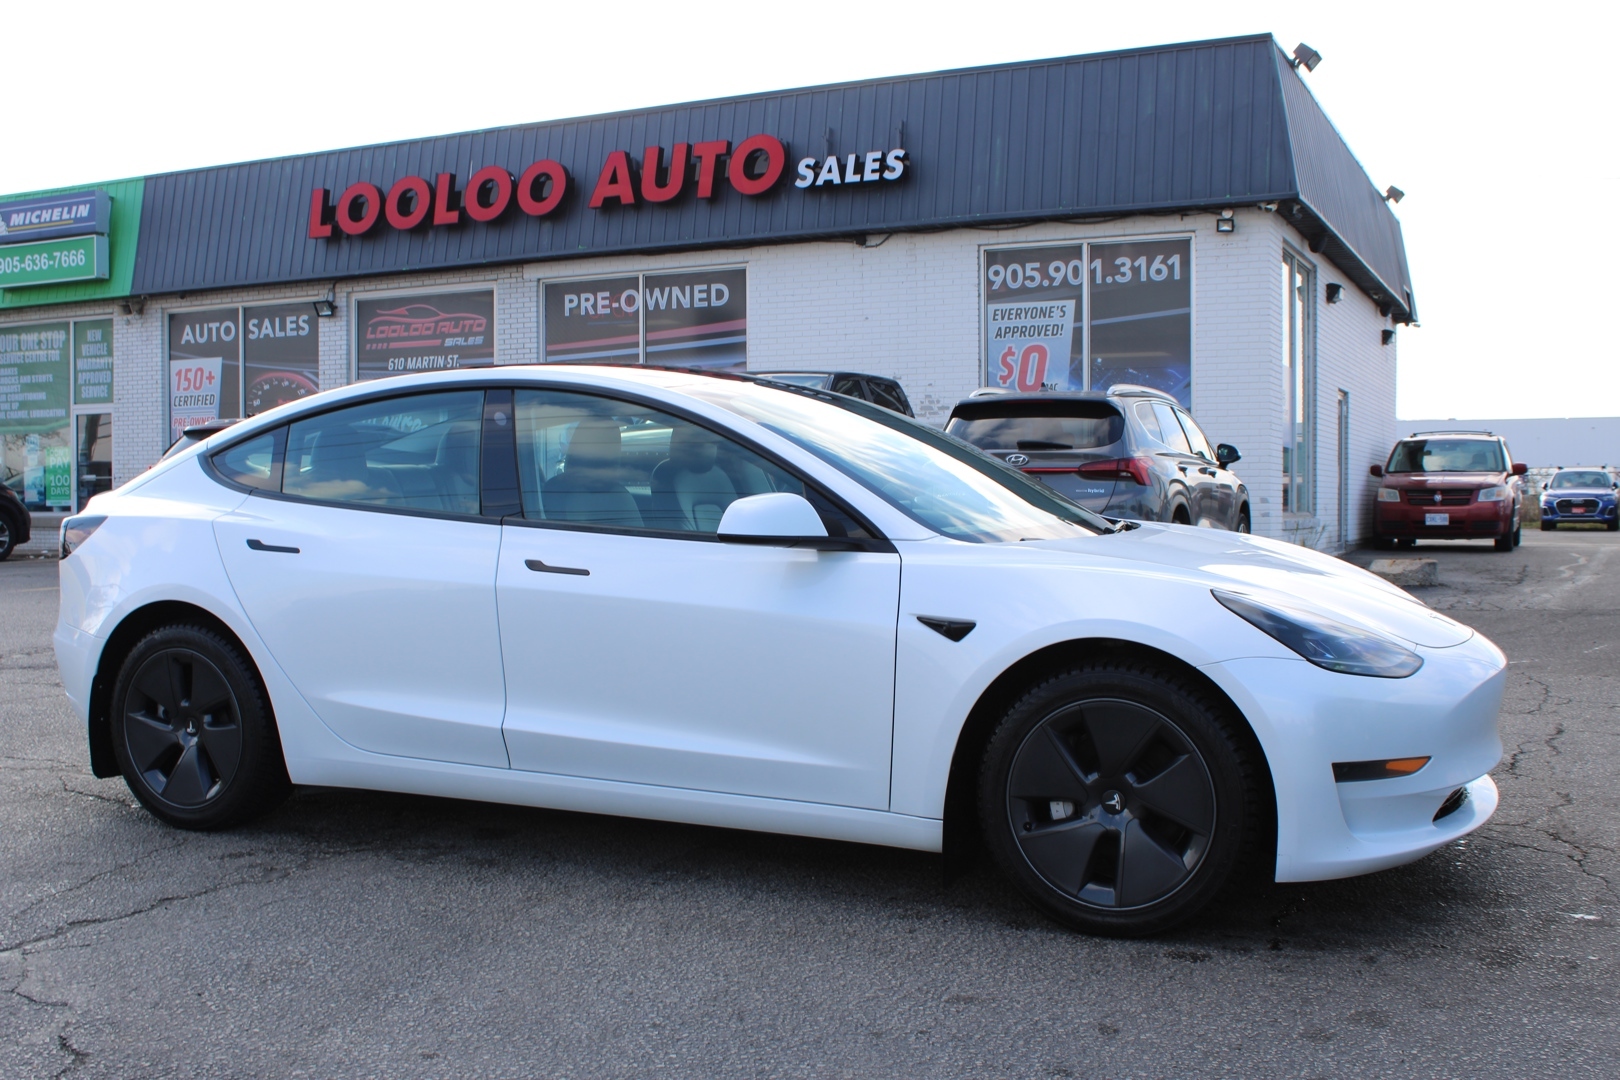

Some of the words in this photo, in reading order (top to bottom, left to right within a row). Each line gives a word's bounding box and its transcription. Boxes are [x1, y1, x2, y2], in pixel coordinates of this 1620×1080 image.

[308, 159, 567, 239] LOOLOO
[587, 134, 785, 209] AUTO
[794, 149, 906, 188] SALES
[9, 204, 90, 226] MICHELIN
[0, 249, 86, 274] 905-636-7666
[987, 254, 1181, 290] 905.901.3161
[564, 283, 730, 317] PRE-OWNED
[992, 304, 1067, 322] EVERYONE'S
[87, 329, 102, 342] NEW
[181, 320, 236, 345] AUTO
[248, 315, 309, 340] SALES
[365, 322, 435, 339] LOOLOO
[436, 319, 487, 335] AUTO
[994, 323, 1064, 340] APPROVED!
[20, 332, 39, 350] ONE
[41, 330, 66, 349] STOP
[444, 335, 485, 347] SALES
[81, 343, 108, 356] VEHICLE
[76, 357, 113, 370] WARRANTY
[388, 357, 404, 371] 610
[407, 355, 445, 370] MARTIN
[446, 354, 460, 368] ST.
[997, 343, 1048, 392] $0
[78, 371, 112, 384] APPROVED
[174, 366, 216, 393] 150+
[81, 385, 108, 398] SERVICE
[173, 394, 216, 408] CERTIFIED
[50, 456, 70, 469] PAY
[50, 474, 70, 487] 100
[50, 487, 70, 496] DAYS
